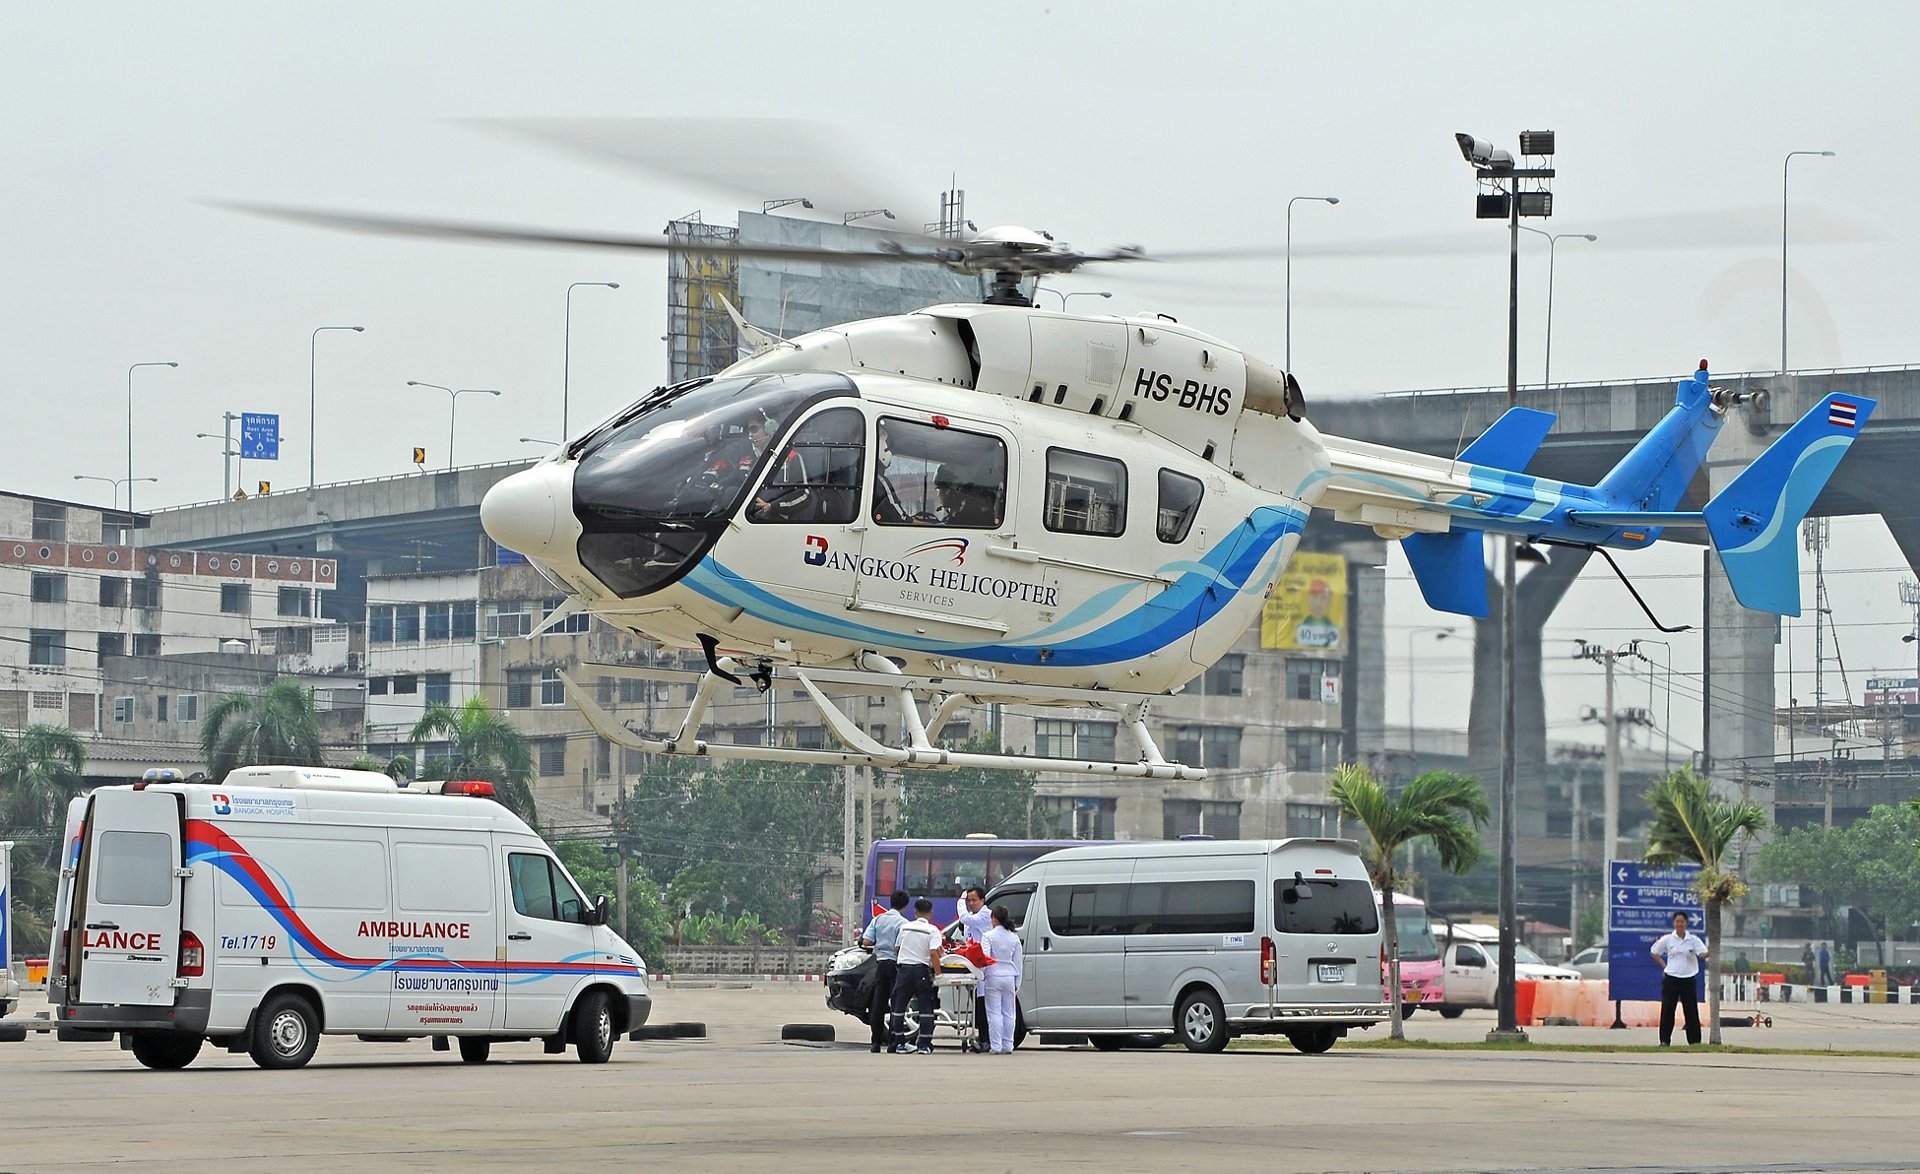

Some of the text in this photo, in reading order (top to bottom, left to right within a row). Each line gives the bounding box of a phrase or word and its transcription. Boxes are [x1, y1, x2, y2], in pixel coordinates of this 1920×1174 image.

[1133, 367, 1232, 416] HS-BHS
[803, 534, 1058, 607] BANGKOK HELICOPTER
[899, 589, 954, 607] SERVICES
[266, 808, 295, 816] HOSPITAL
[83, 930, 161, 950] LANCE
[357, 921, 470, 939] AMBULANCE
[394, 971, 499, 996] โรงพยาบาลกรุงเทพ
